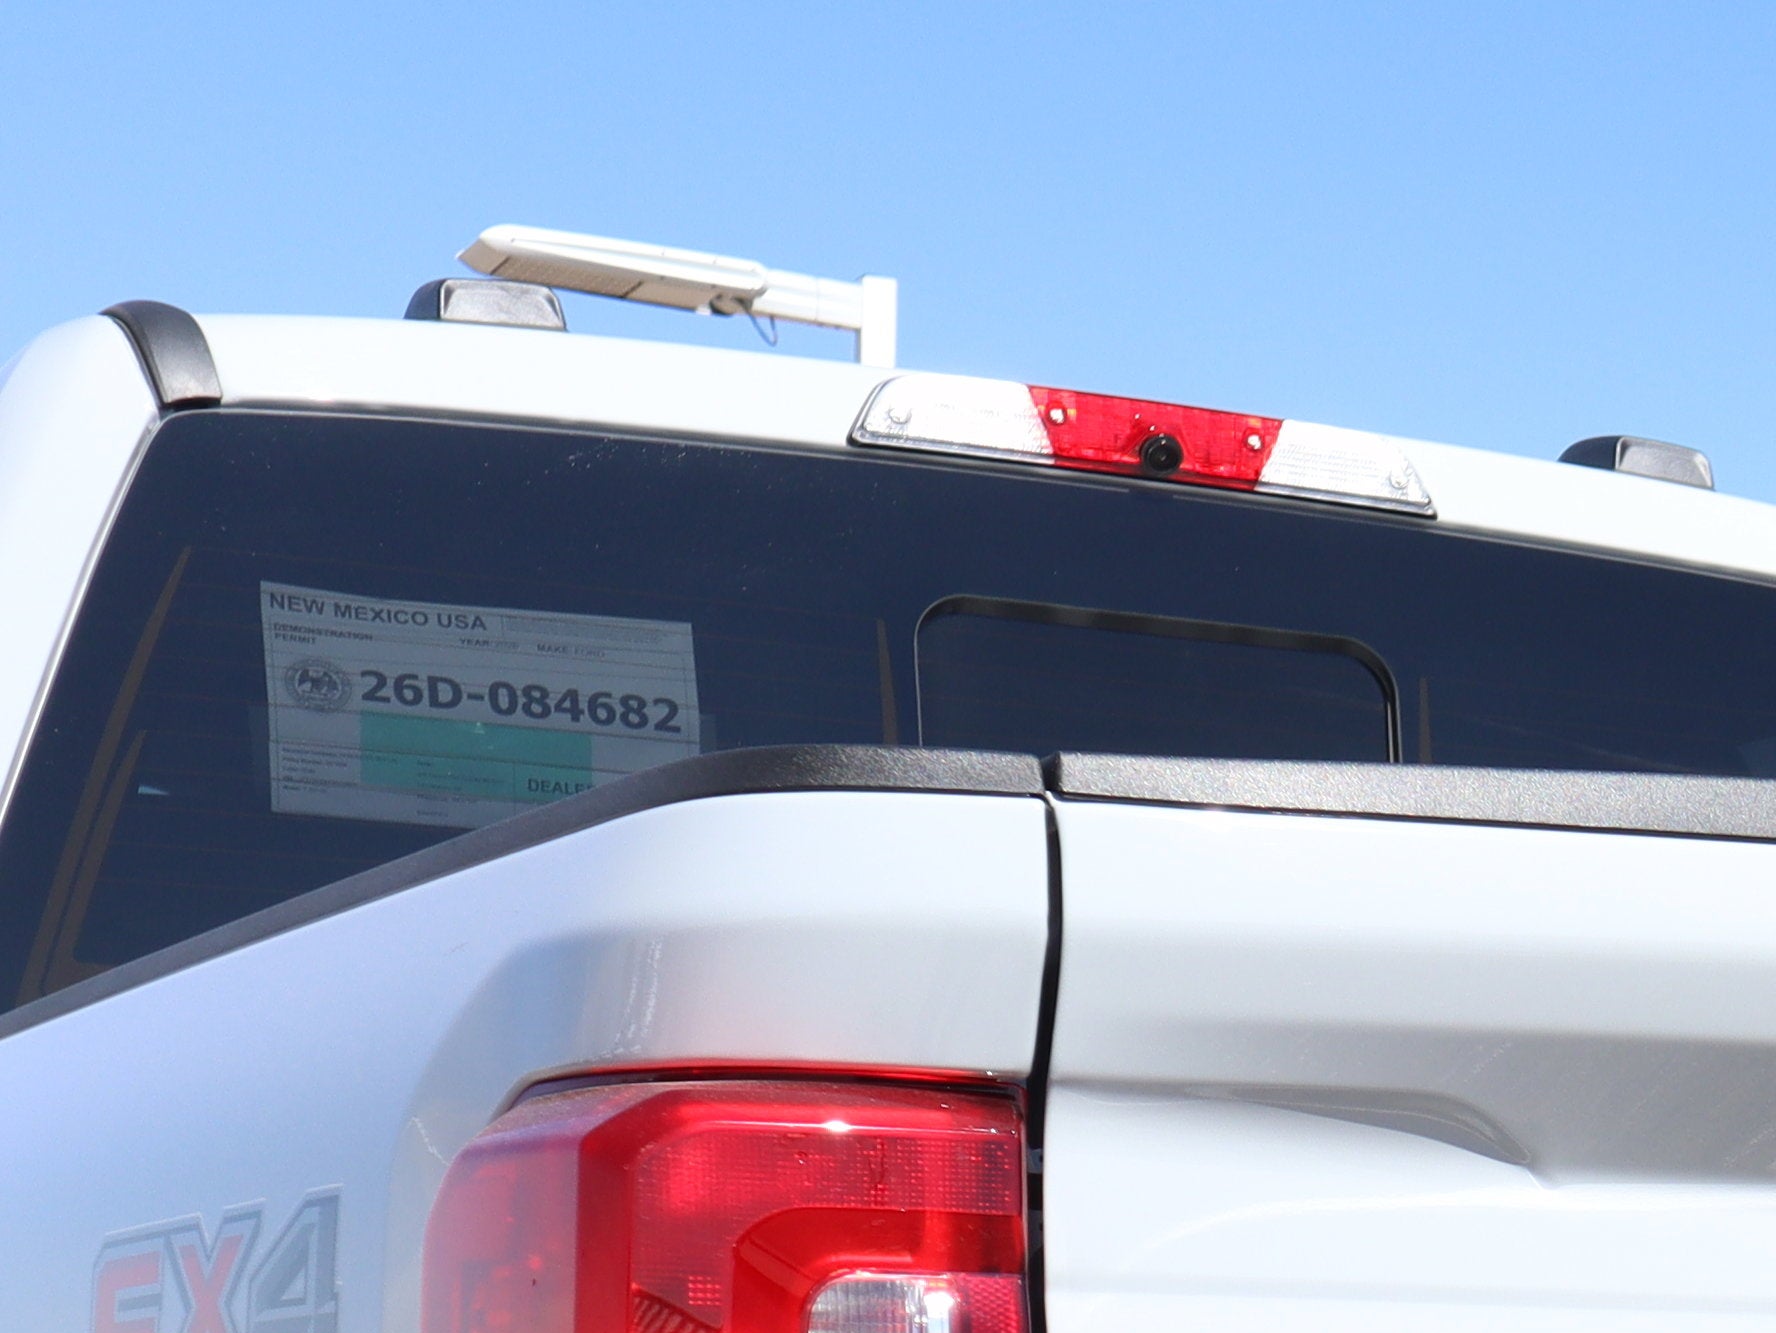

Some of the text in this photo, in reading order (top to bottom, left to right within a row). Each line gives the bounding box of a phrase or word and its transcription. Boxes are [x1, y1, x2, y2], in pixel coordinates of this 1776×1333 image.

[269, 592, 325, 616] NEW
[333, 601, 429, 627] MEXICO
[436, 612, 487, 631] USA
[274, 633, 316, 645] PERMIT
[359, 669, 682, 735] 26D-084682
